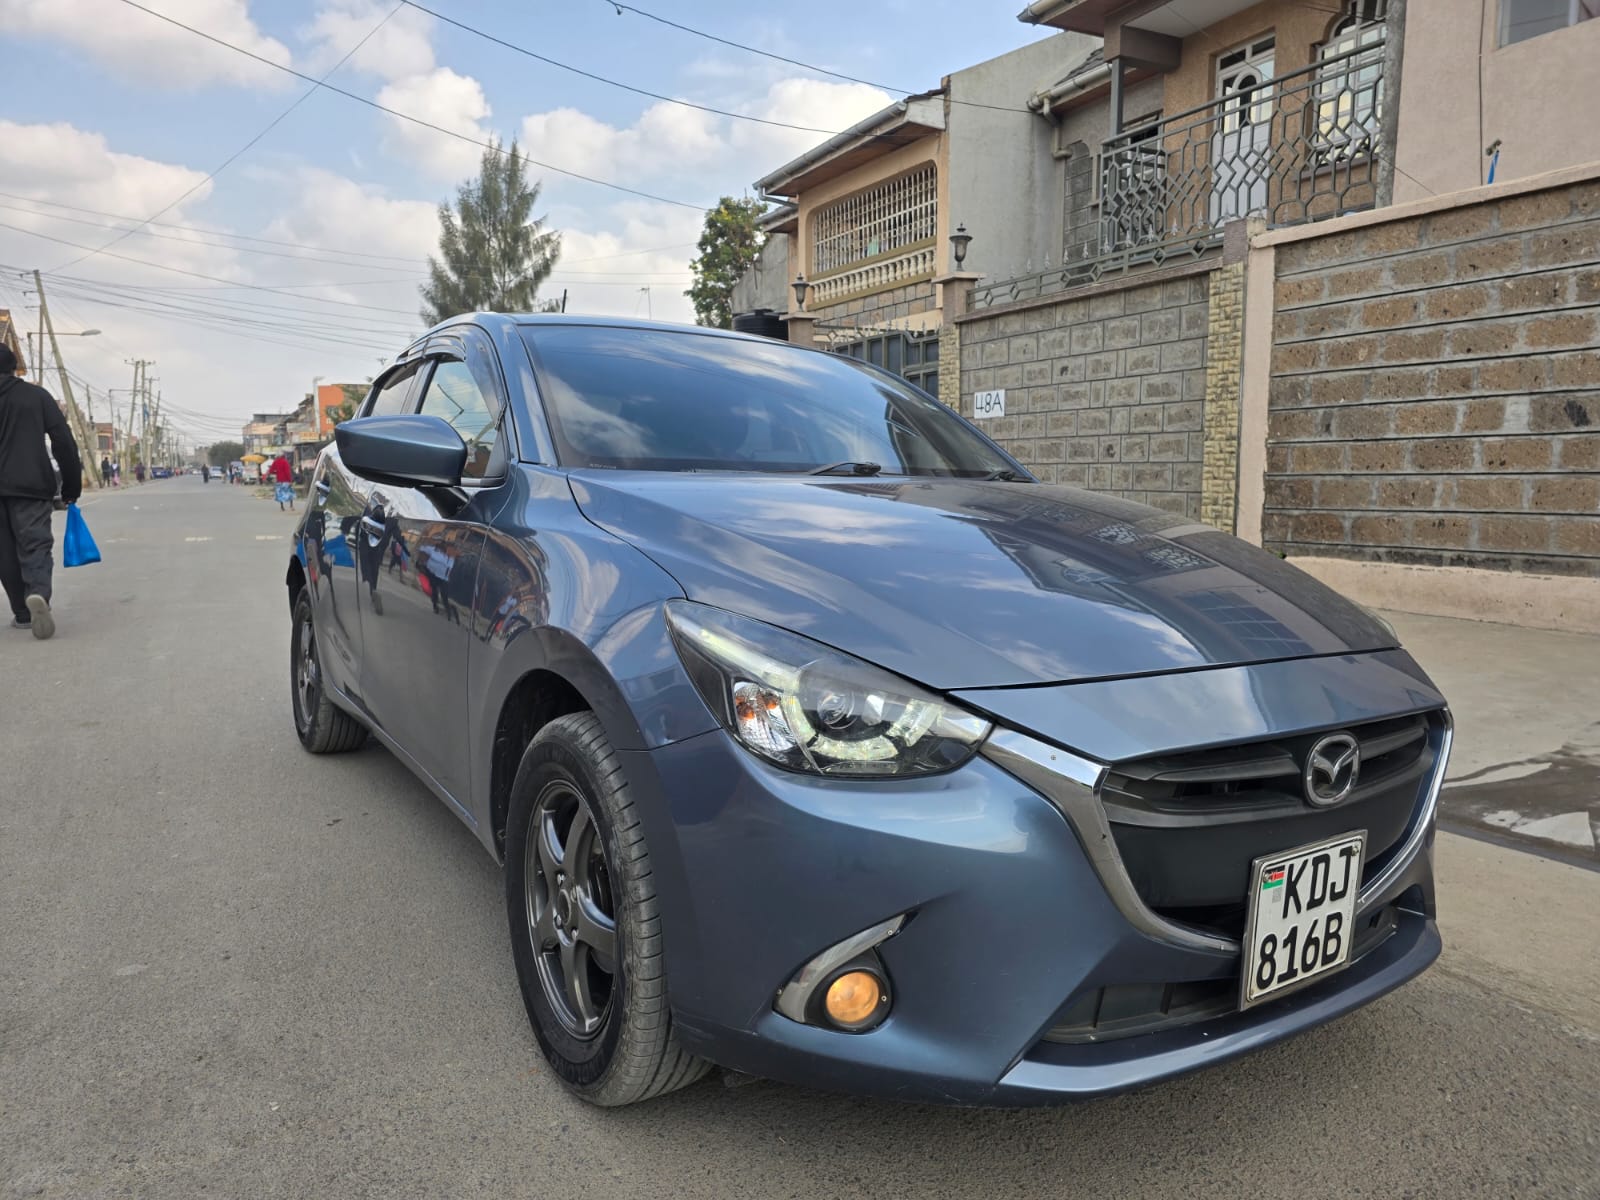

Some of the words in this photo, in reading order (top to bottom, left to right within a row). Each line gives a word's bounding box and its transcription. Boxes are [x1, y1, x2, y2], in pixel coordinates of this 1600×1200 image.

[975, 392, 1003, 413] 48A
[1282, 846, 1353, 919] KDJ
[1256, 912, 1343, 990] 816B
